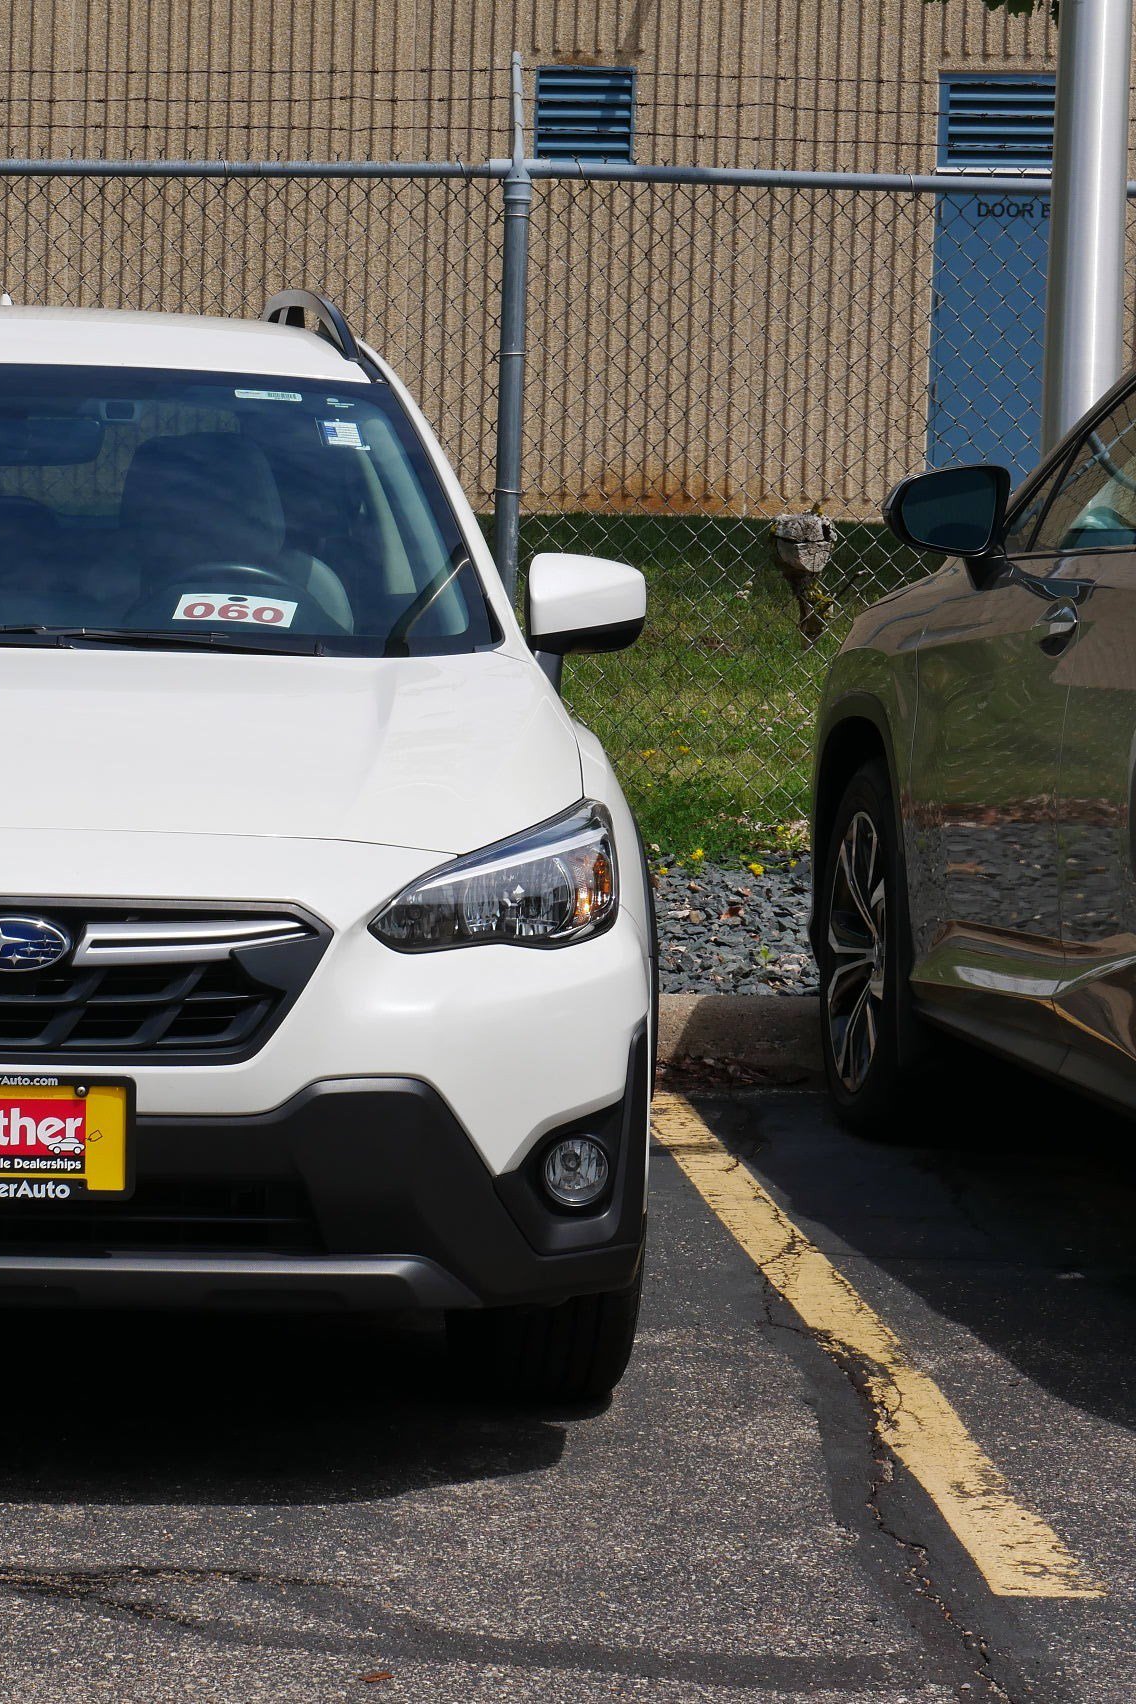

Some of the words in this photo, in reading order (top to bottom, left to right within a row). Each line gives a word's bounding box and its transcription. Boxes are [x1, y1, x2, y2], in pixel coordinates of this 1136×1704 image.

[977, 202, 1034, 218] DOOR
[183, 602, 284, 624] 060
[14, 1158, 82, 1171] Dealerships
